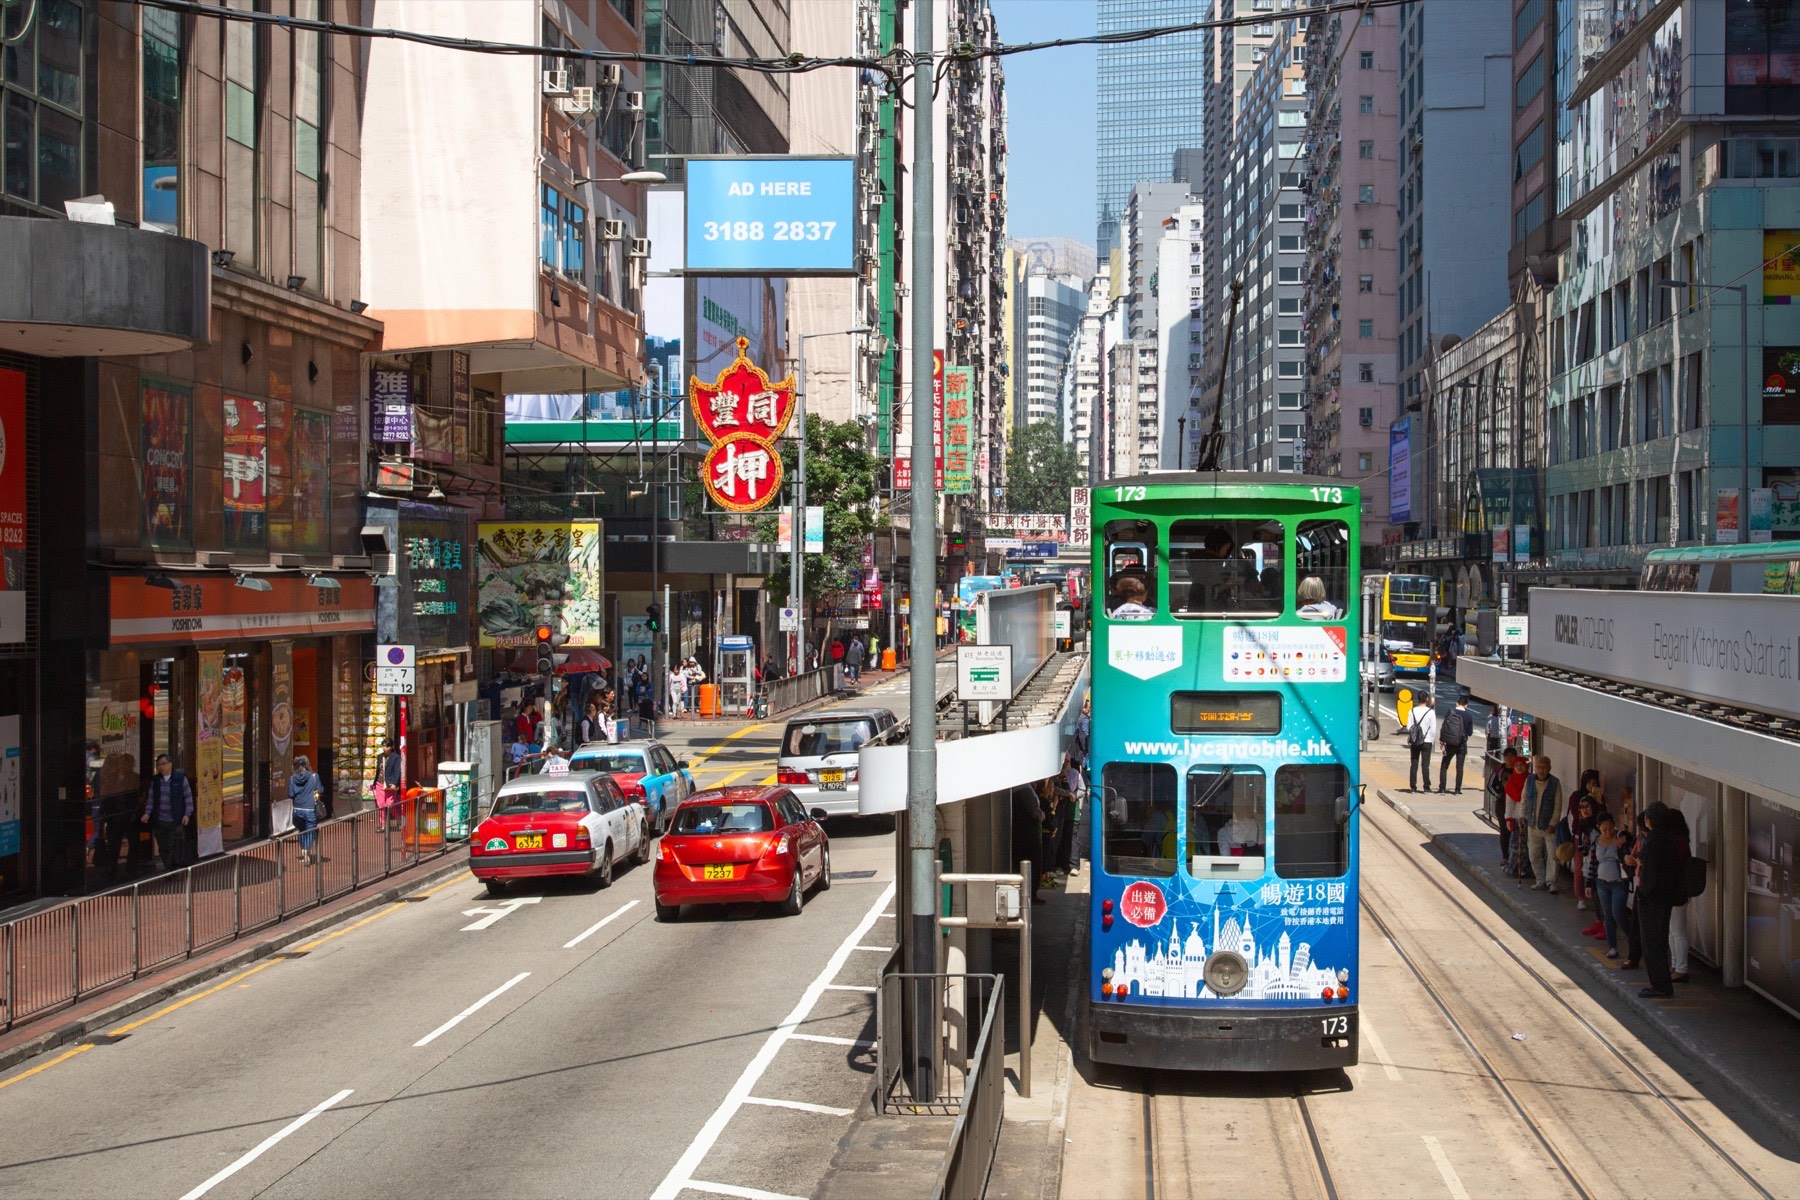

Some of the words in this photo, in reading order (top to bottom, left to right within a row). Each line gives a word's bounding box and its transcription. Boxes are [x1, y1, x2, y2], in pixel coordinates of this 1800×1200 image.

[728, 182, 754, 196] AD
[760, 182, 812, 196] HERE
[703, 221, 764, 241] 3188
[773, 221, 836, 241] 2837
[945, 372, 969, 471] 新都酒店
[147, 448, 184, 469] CONCERT
[713, 443, 770, 500] 押
[1115, 486, 1147, 502] 173
[1310, 487, 1342, 504] 173
[1, 513, 23, 525] SPACES
[4, 528, 23, 543] 8262
[492, 528, 584, 548] 香港魚蛋皇
[172, 583, 203, 613] 吉野家
[172, 618, 203, 631] YOSHINOYA
[1555, 614, 1578, 646] KOHLER
[1579, 617, 1614, 652] KITCHENS
[1653, 622, 1689, 670] Elegant
[1692, 626, 1740, 672] Kitchens
[1744, 630, 1774, 676] Start
[1779, 637, 1792, 679] at
[401, 669, 407, 678] 7
[401, 683, 413, 693] 12
[1125, 739, 1332, 759] www.lycamobile.hk
[519, 840, 541, 848] 6372
[706, 871, 731, 879] 7237
[1131, 890, 1157, 904] 出遊
[1261, 882, 1345, 906] 暢遊18國
[1130, 906, 1157, 920] 必備
[1321, 1016, 1348, 1035] 173
